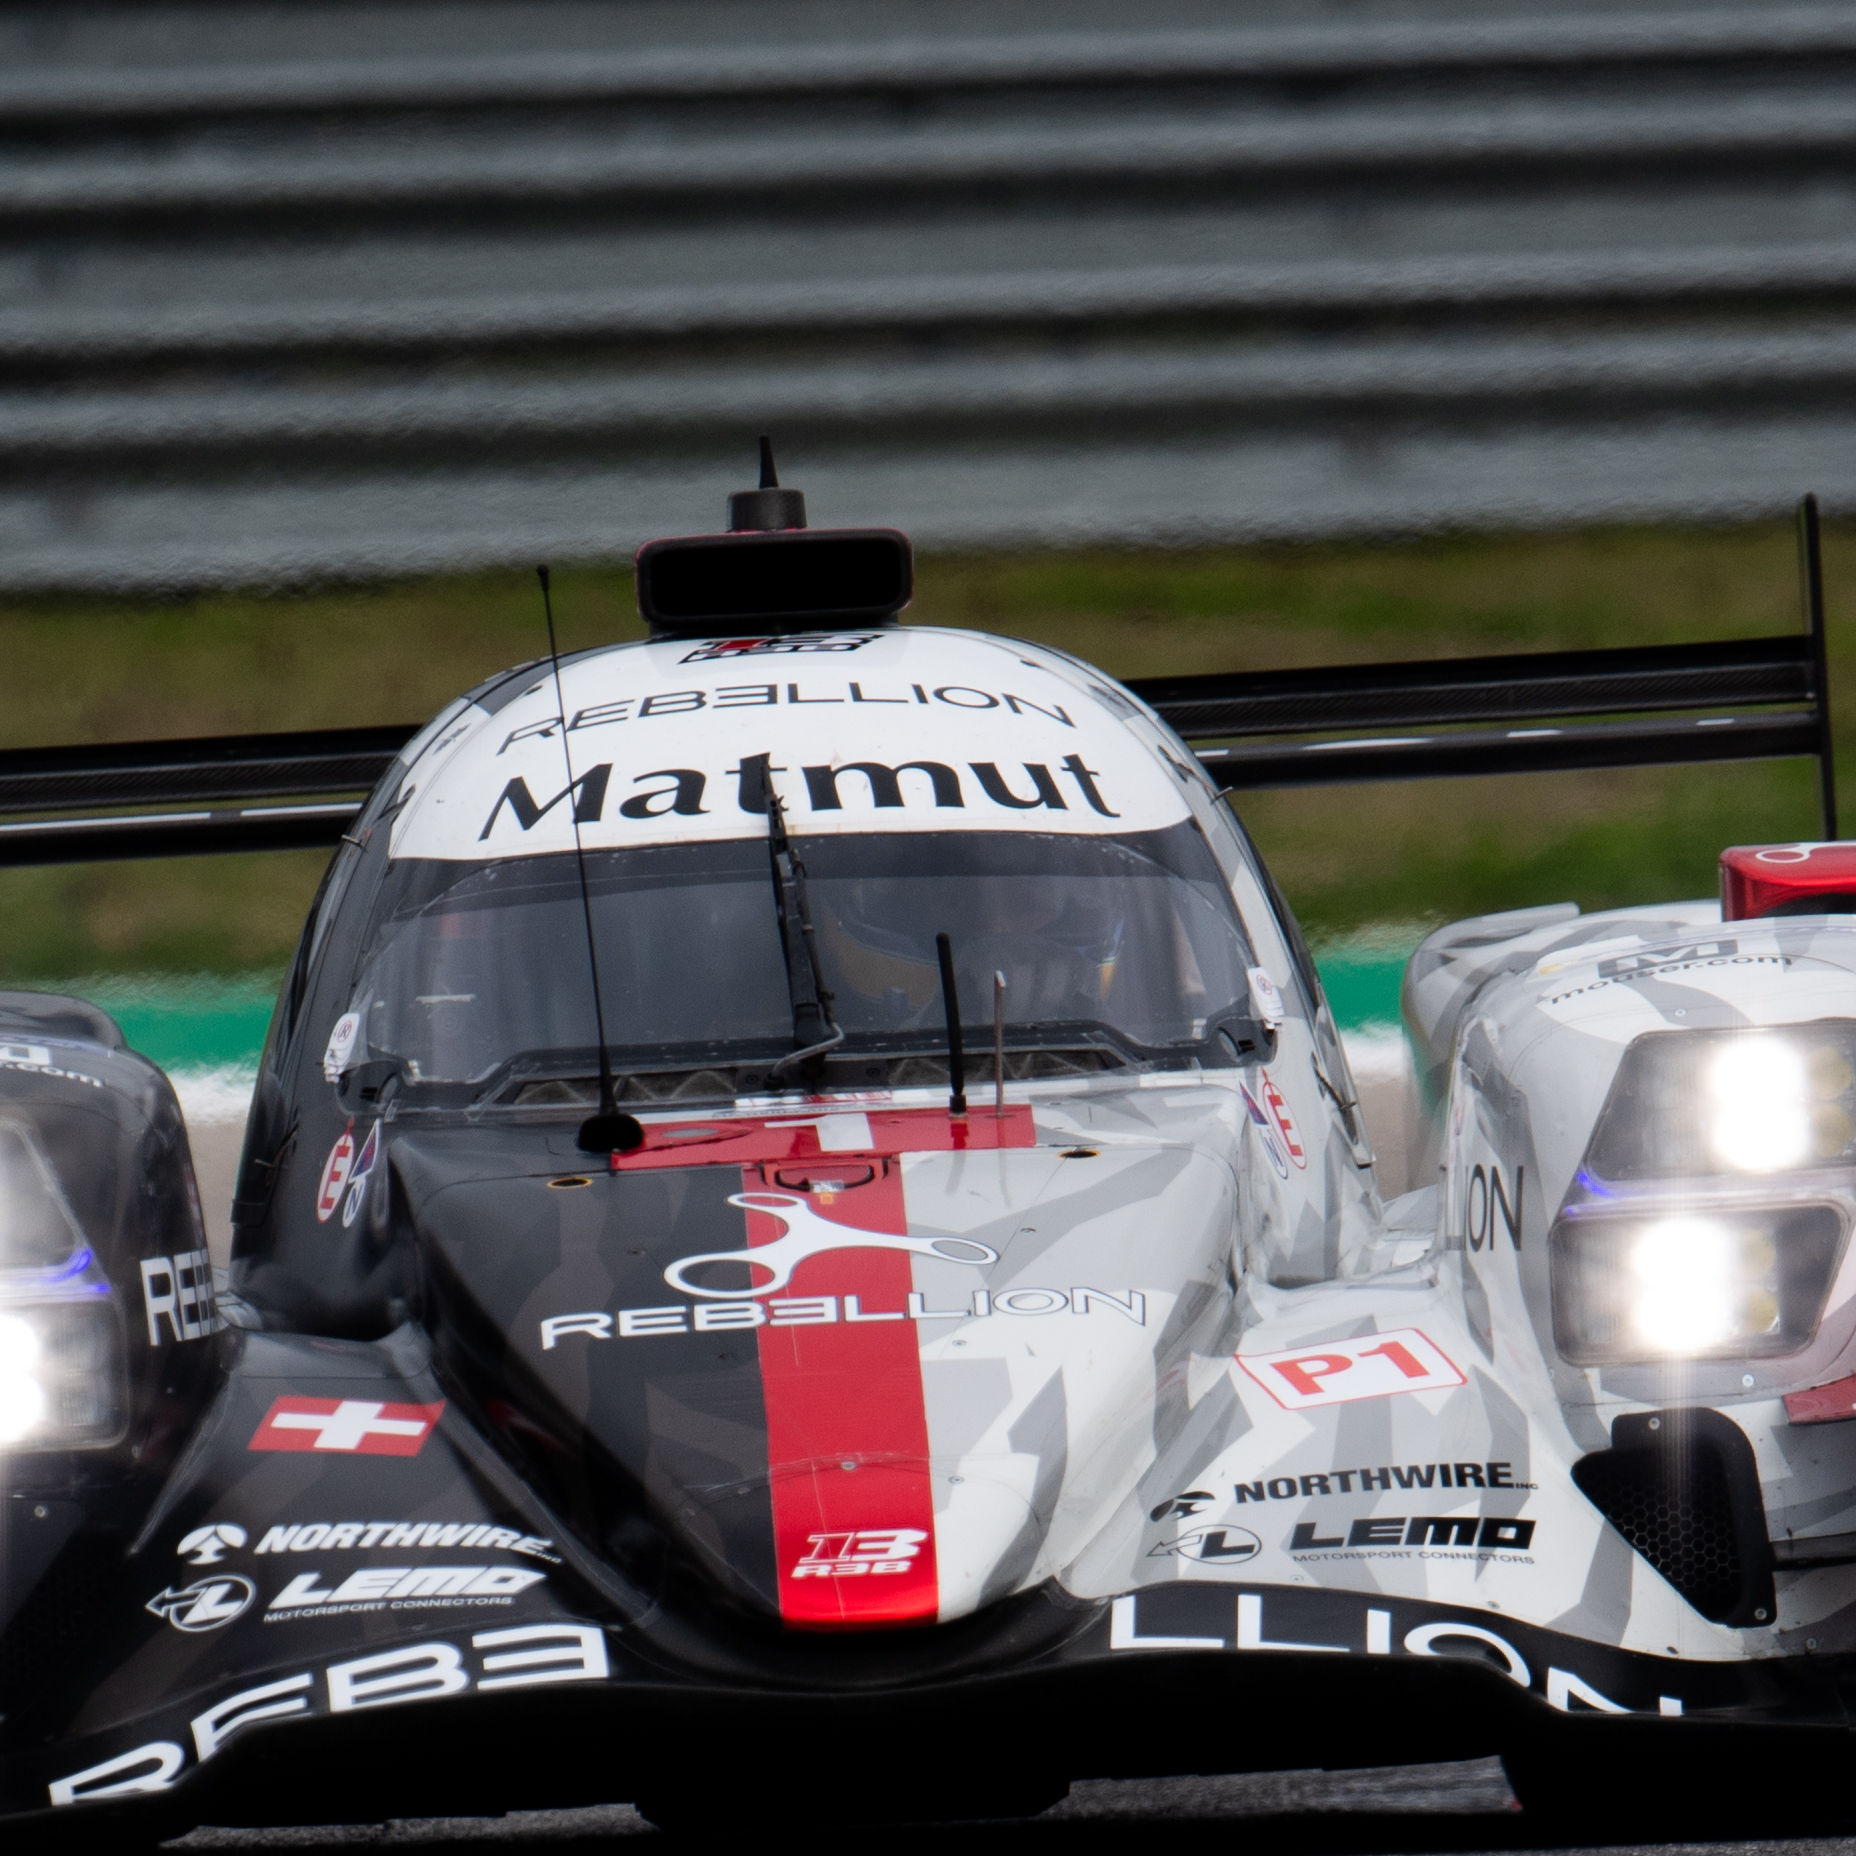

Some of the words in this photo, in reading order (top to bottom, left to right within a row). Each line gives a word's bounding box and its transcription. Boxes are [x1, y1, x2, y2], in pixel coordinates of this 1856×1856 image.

[477, 751, 1122, 842] Matmut
[1551, 955, 1793, 1004] mouser.com
[763, 1112, 875, 1152] 1
[1267, 1094, 1304, 1157] E
[320, 1144, 351, 1210] E
[1269, 1340, 1432, 1396] P1
[1233, 1461, 1515, 1504] NORTHWIRE
[254, 1522, 554, 1555] NORTHWIRE
[1289, 1516, 1537, 1551] LEMO
[1293, 1551, 1412, 1563] MOTORSPORT
[1418, 1551, 1535, 1565] CONNECTORS
[263, 1600, 386, 1623] MOTORSPORT
[390, 1596, 514, 1610] CONNECTORS
[268, 1566, 548, 1610] LEMO
